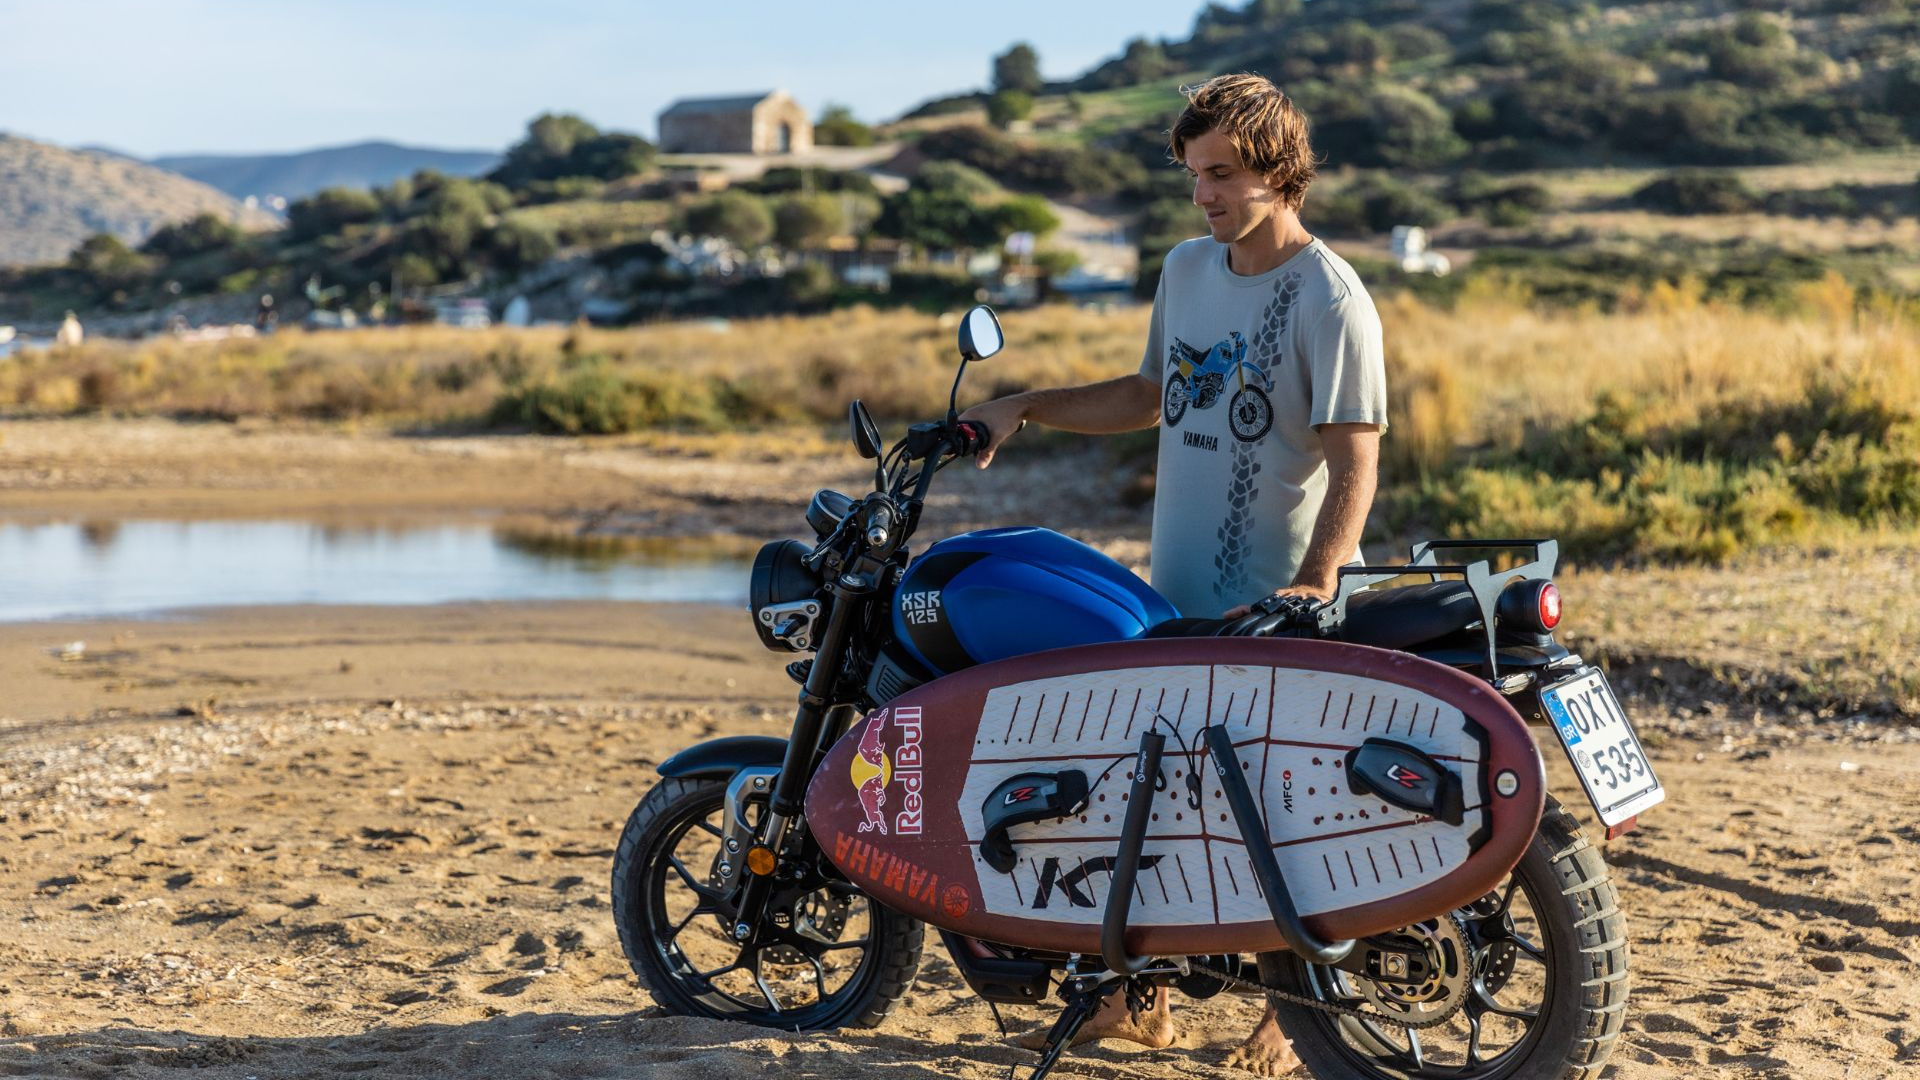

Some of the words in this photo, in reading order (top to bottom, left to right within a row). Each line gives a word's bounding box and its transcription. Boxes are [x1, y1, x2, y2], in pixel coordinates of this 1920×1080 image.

[1184, 431, 1218, 451] YAMAHA
[902, 591, 940, 610] XSR
[907, 609, 937, 624] 125
[1562, 725, 1577, 741] GR
[1566, 685, 1616, 734] OXT
[894, 706, 922, 767] Bull
[1592, 738, 1645, 789] 535
[895, 771, 922, 834] Red
[835, 831, 939, 909] YAMAHA
